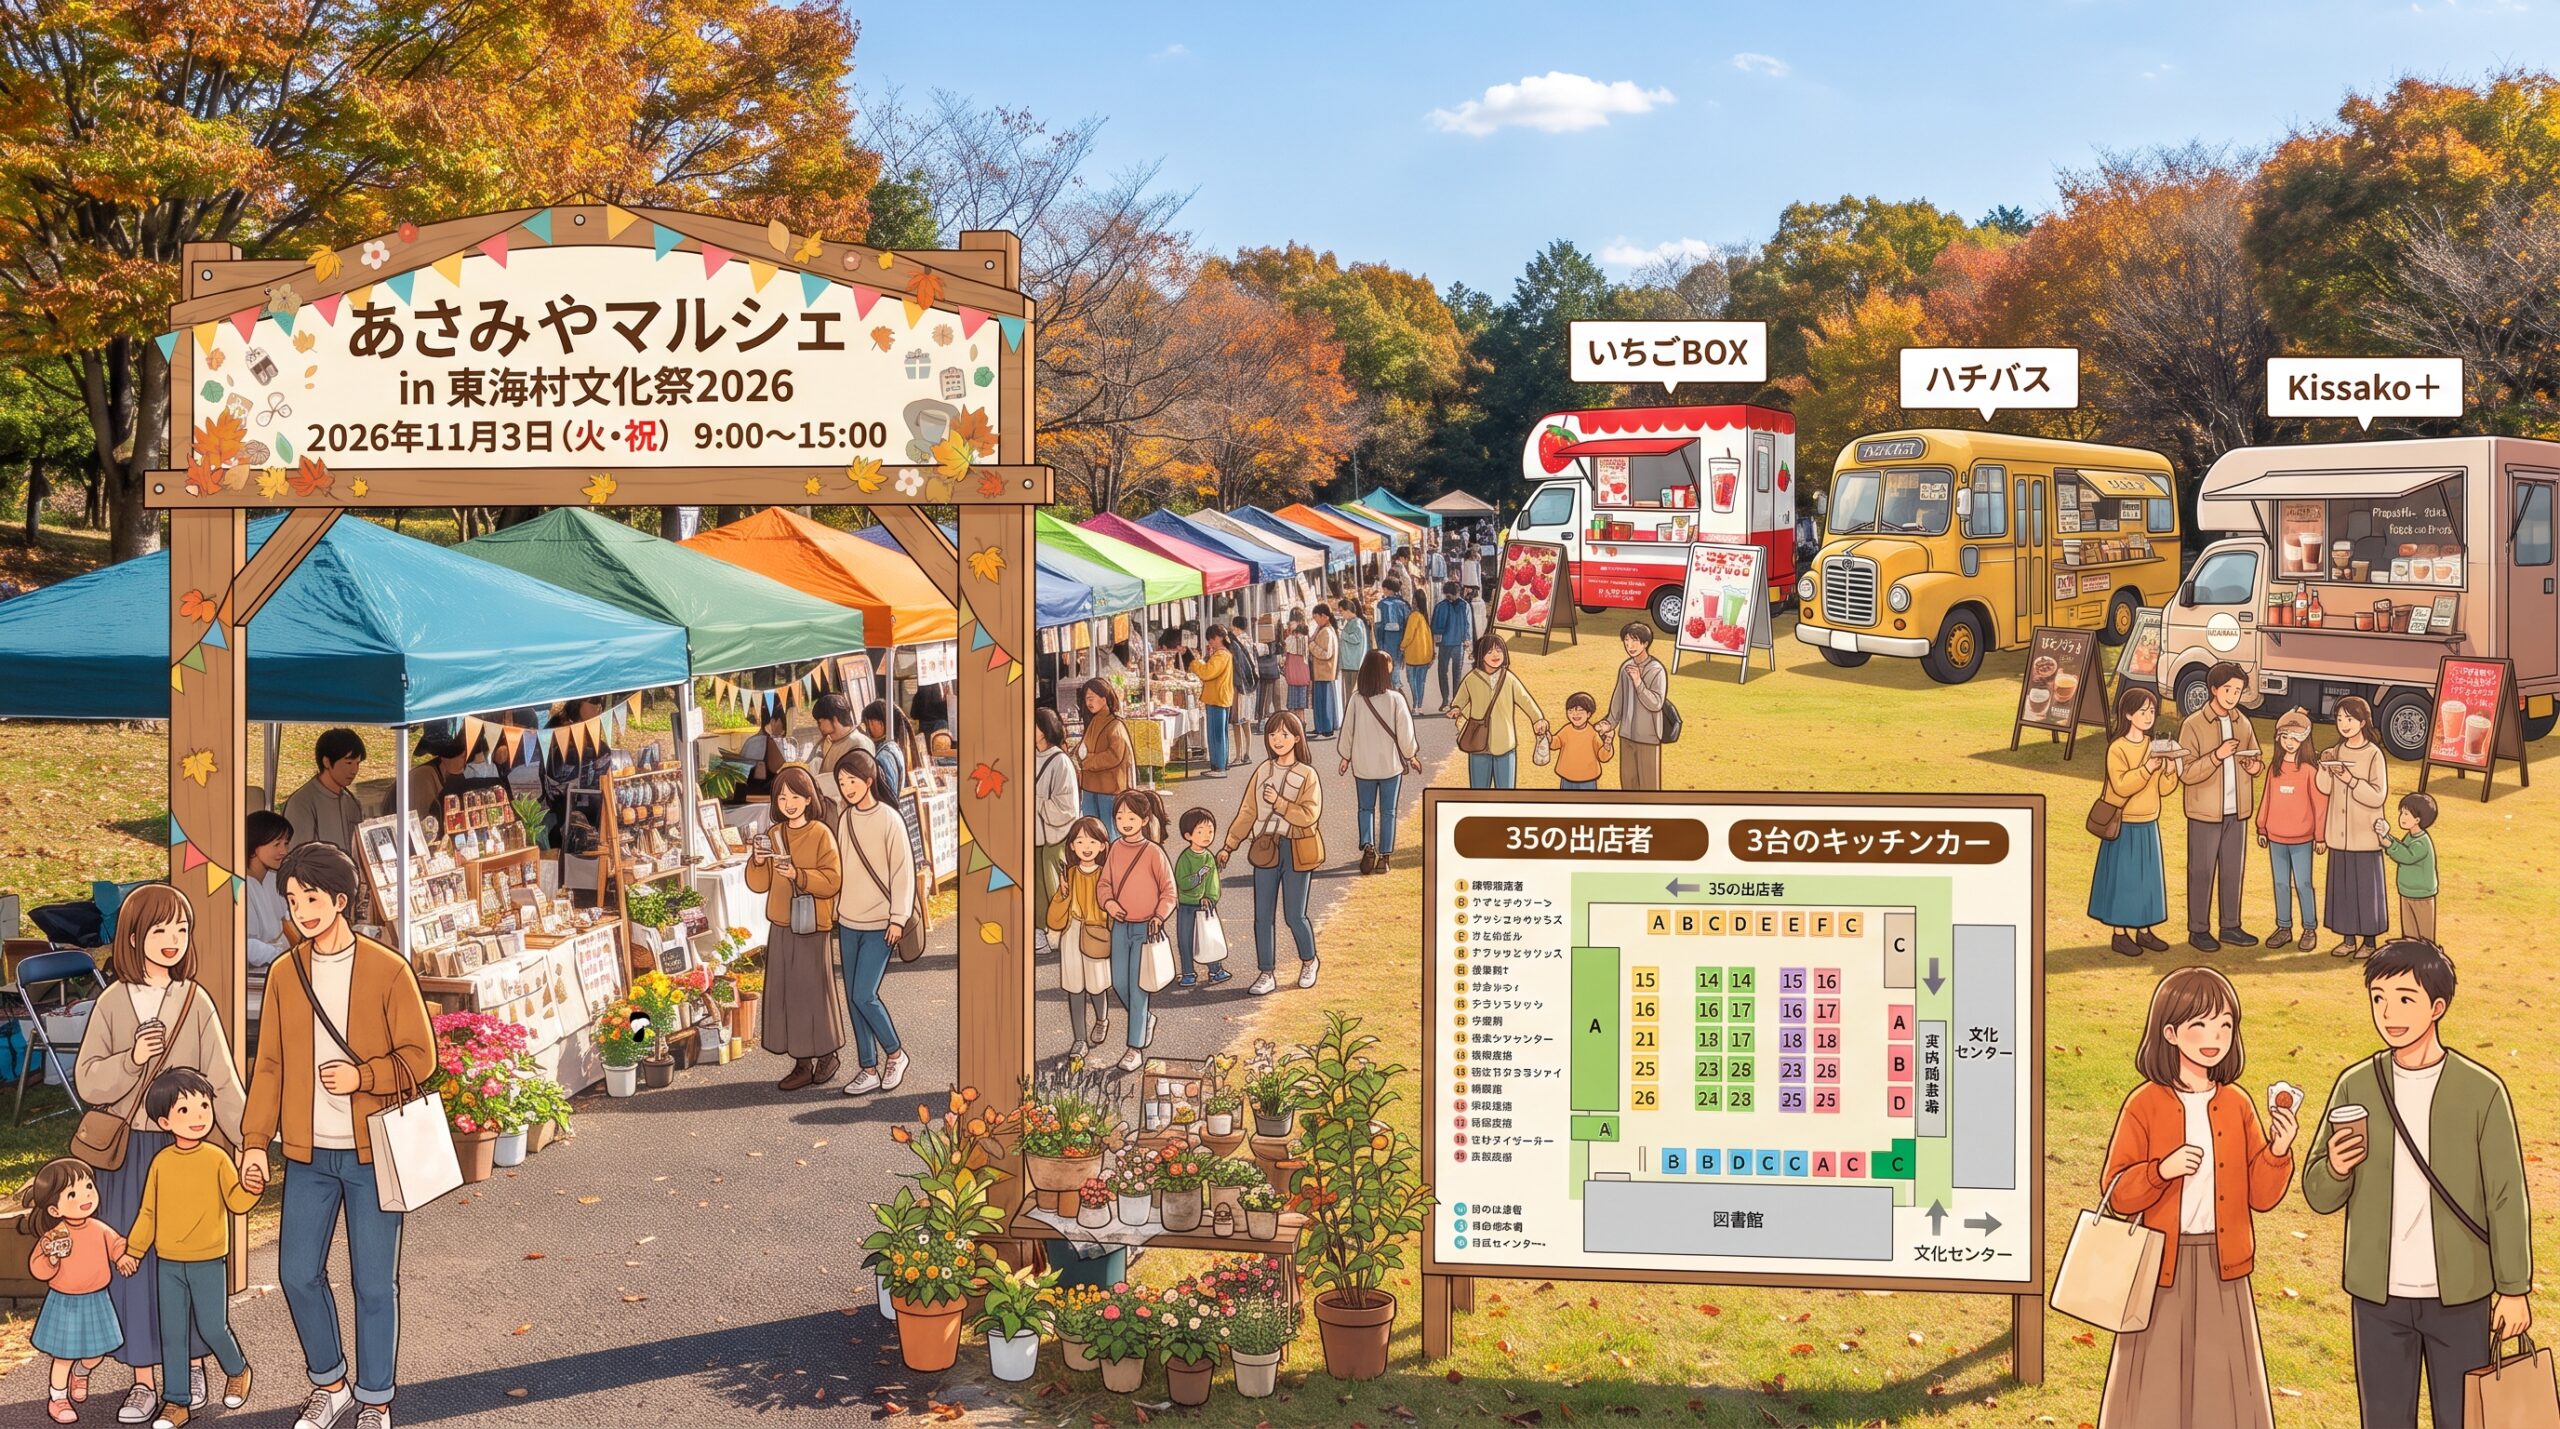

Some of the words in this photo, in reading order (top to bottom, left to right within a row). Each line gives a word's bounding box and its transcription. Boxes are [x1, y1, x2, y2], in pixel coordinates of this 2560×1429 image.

[348, 294, 846, 360] あさみやマルシェ
[1590, 336, 1747, 366] いちごBOX
[1927, 363, 2049, 392] ハチバス
[400, 371, 434, 404] in
[448, 366, 793, 407] 東海村文化祭2026
[1505, 825, 1654, 855] 35の出店者
[1746, 827, 1992, 856] 3台のキッチンカー
[1709, 882, 1784, 896] 35の出店者
[1653, 916, 1664, 929] A
[1683, 917, 1692, 930] B
[1709, 917, 1719, 930] C
[1736, 917, 1746, 931] D
[1763, 918, 1771, 931] E
[1790, 918, 1798, 931] E
[1819, 918, 1827, 931] F
[1846, 919, 1856, 932] C
[1894, 938, 1905, 952] C
[1636, 973, 1654, 987] 15
[1701, 974, 1718, 987] 14
[1733, 974, 1751, 987] 14
[1784, 974, 1802, 988] 15
[1818, 975, 1836, 988] 16
[1636, 1002, 1654, 1016] 16
[1700, 1003, 1718, 1017] 16
[1733, 1003, 1750, 1017] 17
[1784, 1004, 1802, 1018] 16
[1818, 1004, 1836, 1018] 17
[1590, 1019, 1601, 1033] A
[1894, 1016, 1905, 1029] A
[1636, 1032, 1654, 1046] 21
[1733, 1033, 1750, 1047] 17
[1784, 1034, 1802, 1047] 18
[1818, 1034, 1836, 1048] 18
[1969, 1027, 1998, 1042] 文化
[1955, 1046, 2012, 1059] センター
[1636, 1062, 1654, 1075] 25
[1699, 1063, 1717, 1076] 23
[1895, 1057, 1904, 1071] B
[1636, 1091, 1654, 1104] 26
[1783, 1093, 1801, 1107] 25
[1816, 1093, 1835, 1107] 25
[1895, 1096, 1905, 1110] D
[1600, 1123, 1610, 1136] A
[1669, 1155, 1679, 1168] B
[1703, 1156, 1713, 1168] B
[1734, 1156, 1744, 1169] D
[1763, 1157, 1773, 1170] C
[1790, 1157, 1800, 1170] C
[1818, 1158, 1829, 1171] A
[1848, 1158, 1857, 1171] C
[1892, 1157, 1903, 1171] C
[1714, 1211, 1763, 1228] 図書館
[1915, 1245, 2012, 1262] 文化センター
